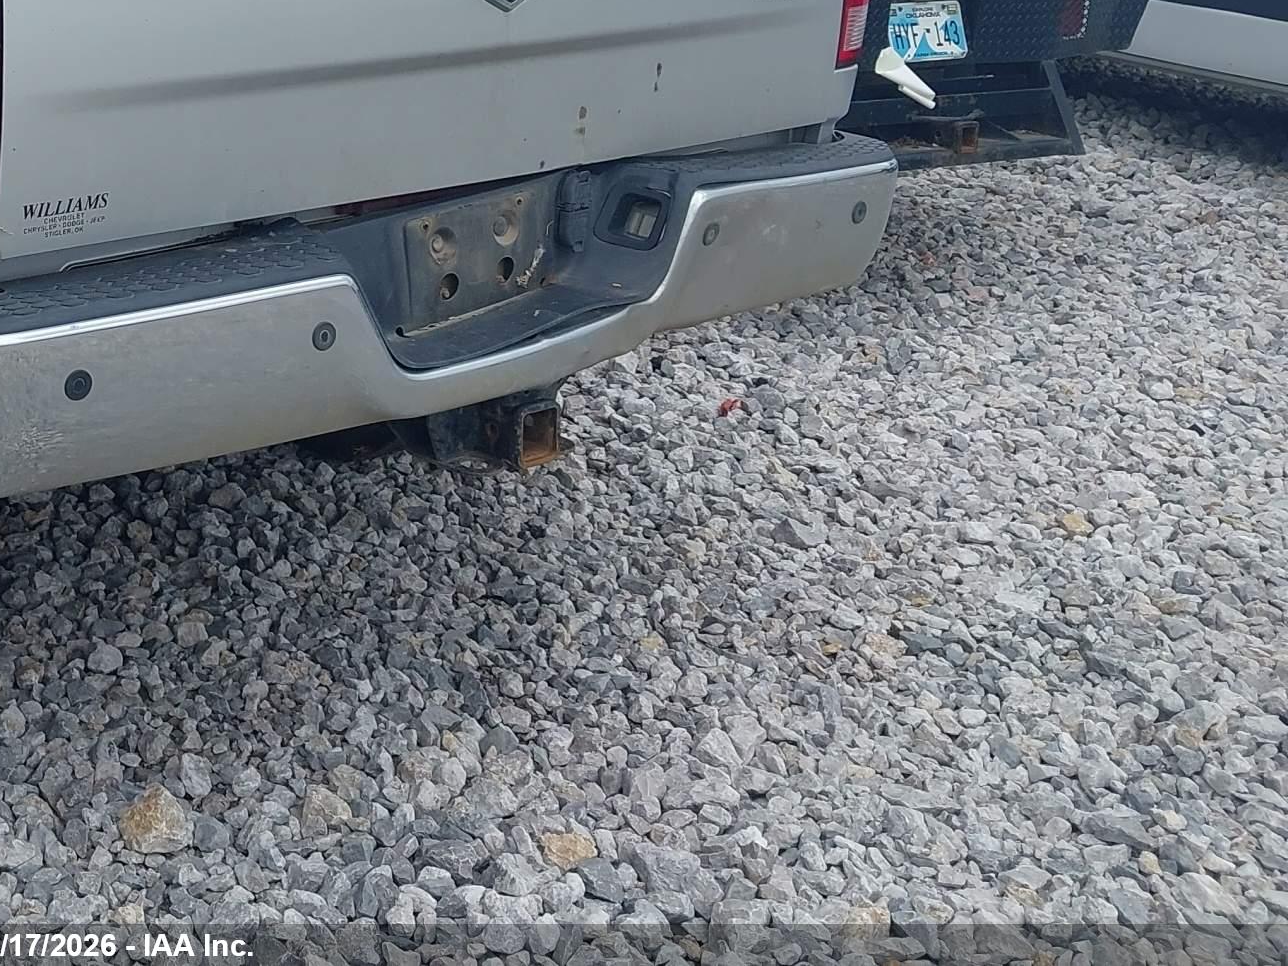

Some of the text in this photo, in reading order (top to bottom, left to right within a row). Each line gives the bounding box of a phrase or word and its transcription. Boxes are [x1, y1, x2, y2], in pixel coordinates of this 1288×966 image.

[22, 192, 109, 220] WILLIAMS
[43, 212, 84, 225] CHEVROLET
[62, 218, 84, 228] DODGE
